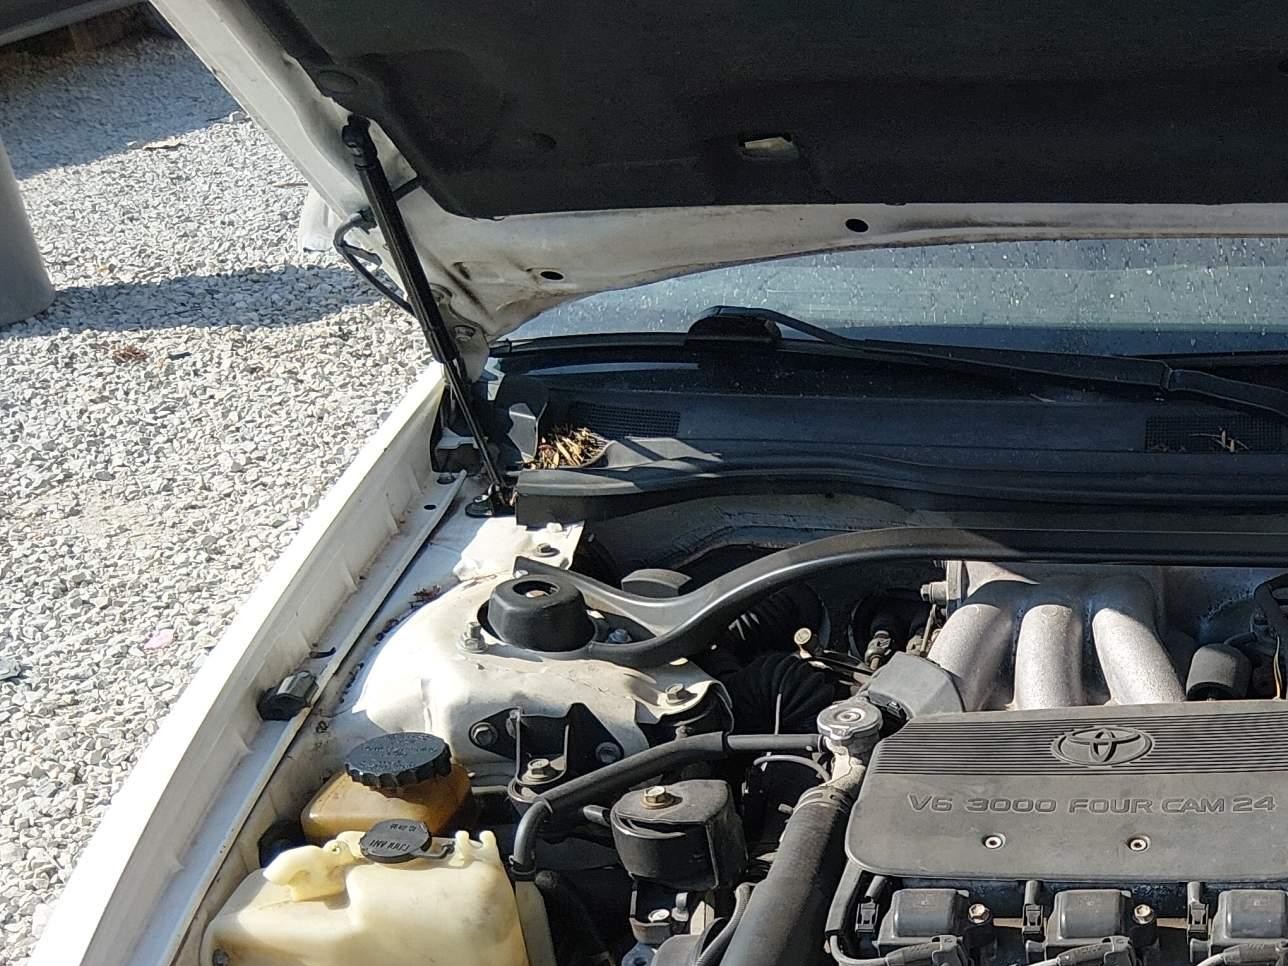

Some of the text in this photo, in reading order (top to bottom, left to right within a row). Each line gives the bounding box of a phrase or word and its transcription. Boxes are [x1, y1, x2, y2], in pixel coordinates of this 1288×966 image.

[908, 793, 1276, 814] V6 3000 FOUR CAM 24
